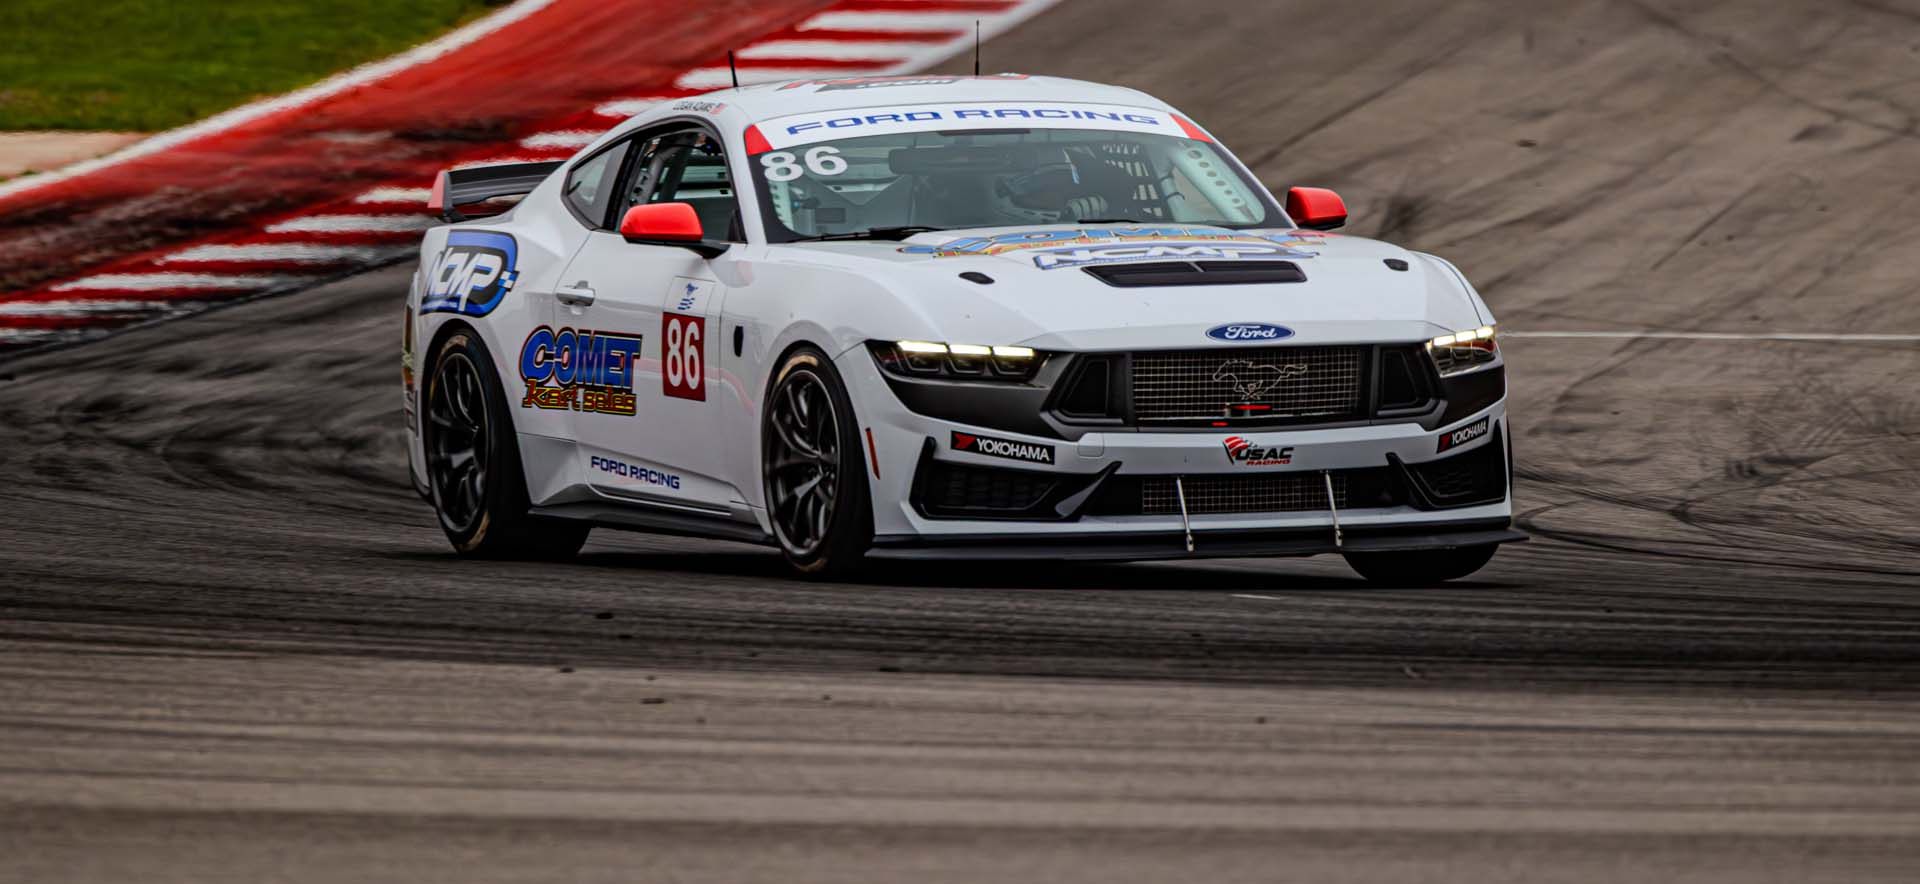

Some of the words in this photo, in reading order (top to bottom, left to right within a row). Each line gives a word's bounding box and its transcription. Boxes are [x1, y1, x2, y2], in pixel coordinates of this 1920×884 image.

[786, 110, 943, 136] FORD
[953, 109, 1161, 126] RACING
[760, 145, 848, 182] 86
[1224, 325, 1278, 339] Ford
[518, 325, 643, 391] COMET
[666, 318, 700, 390] 86
[522, 377, 581, 412] kart
[582, 384, 638, 416] sales
[976, 438, 1051, 462] YOKOHAMA
[1235, 446, 1295, 461] USAC
[1246, 459, 1291, 467] RACING
[591, 455, 627, 477] FORD
[629, 465, 680, 490] RACING
